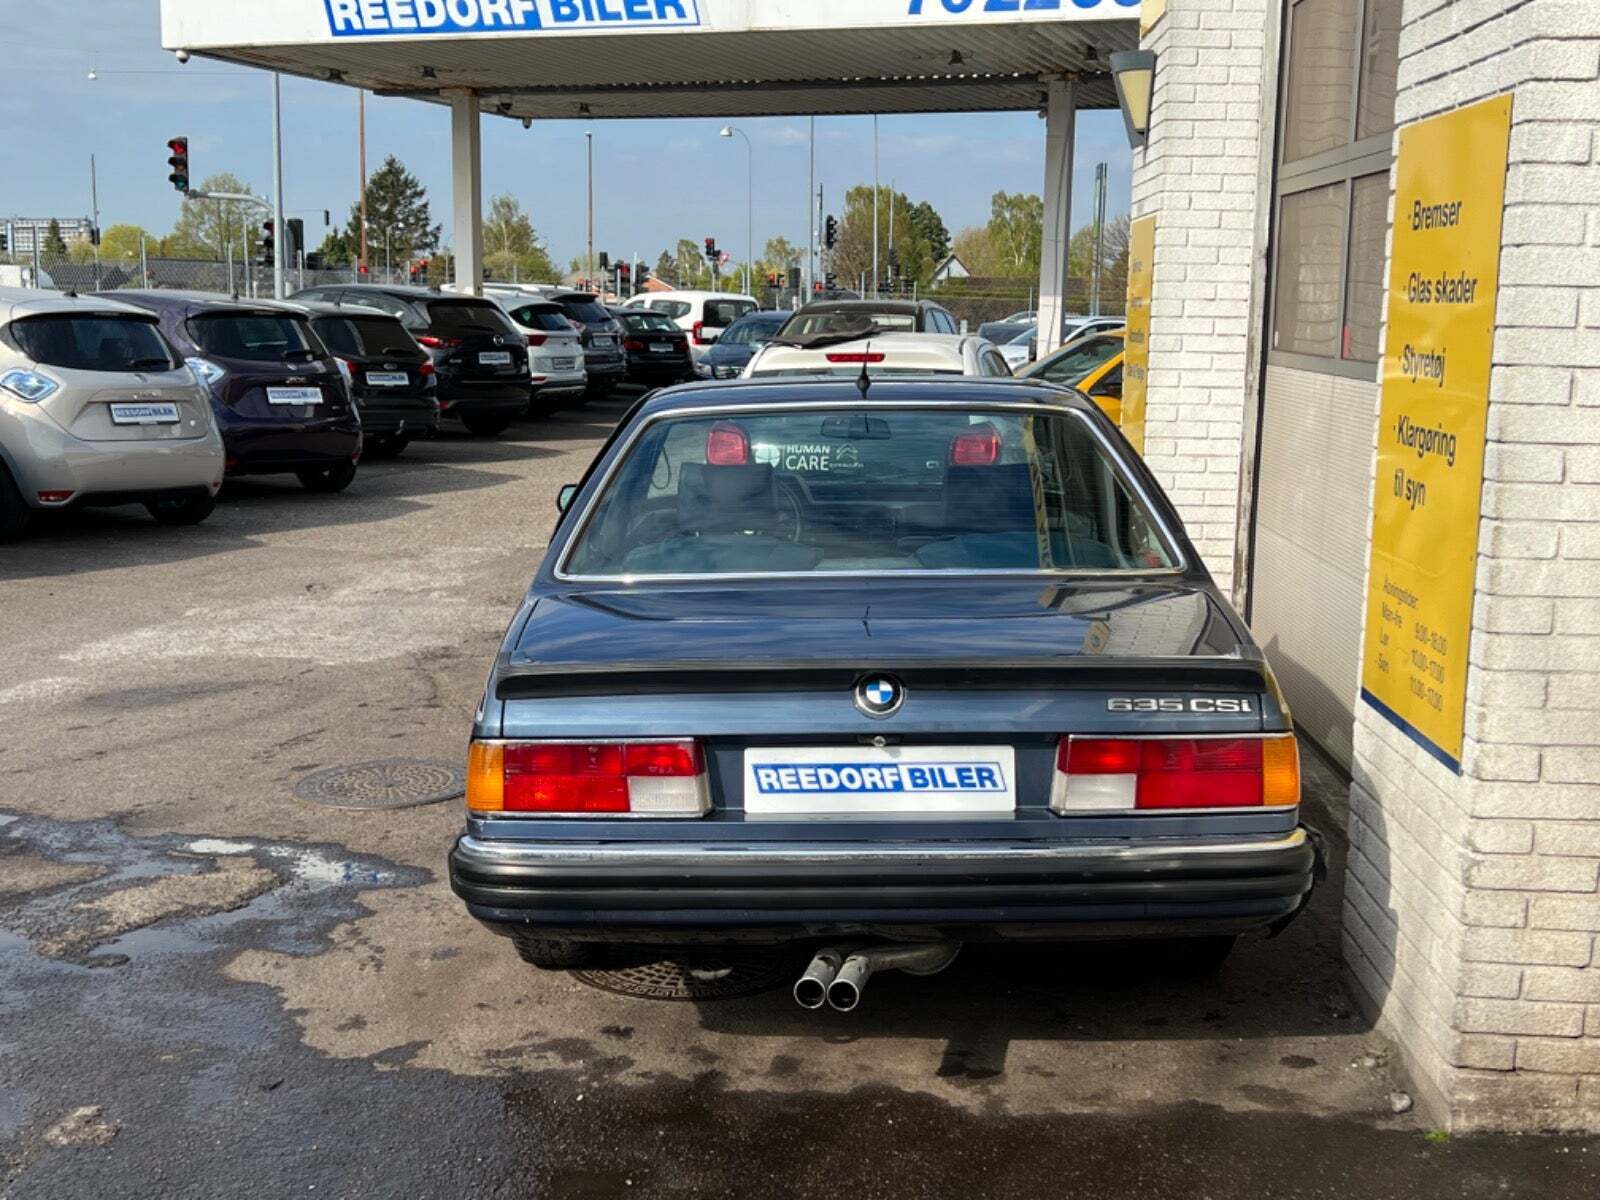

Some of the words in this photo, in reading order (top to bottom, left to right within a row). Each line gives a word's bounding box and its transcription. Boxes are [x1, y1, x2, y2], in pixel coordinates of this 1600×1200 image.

[331, 0, 538, 30] REEDORF
[1412, 200, 1462, 231] Bremser
[1408, 272, 1432, 302] Glas
[1434, 270, 1478, 303] skader
[1402, 344, 1446, 387] Styretøj
[786, 445, 831, 454] HUMAN
[1396, 414, 1456, 467] Klargøring
[785, 455, 830, 471] CARE
[1394, 468, 1404, 497] til
[1406, 478, 1426, 510] syn
[1107, 697, 1184, 712] 635
[756, 767, 899, 790] REEDORF
[907, 767, 999, 789] BILER
